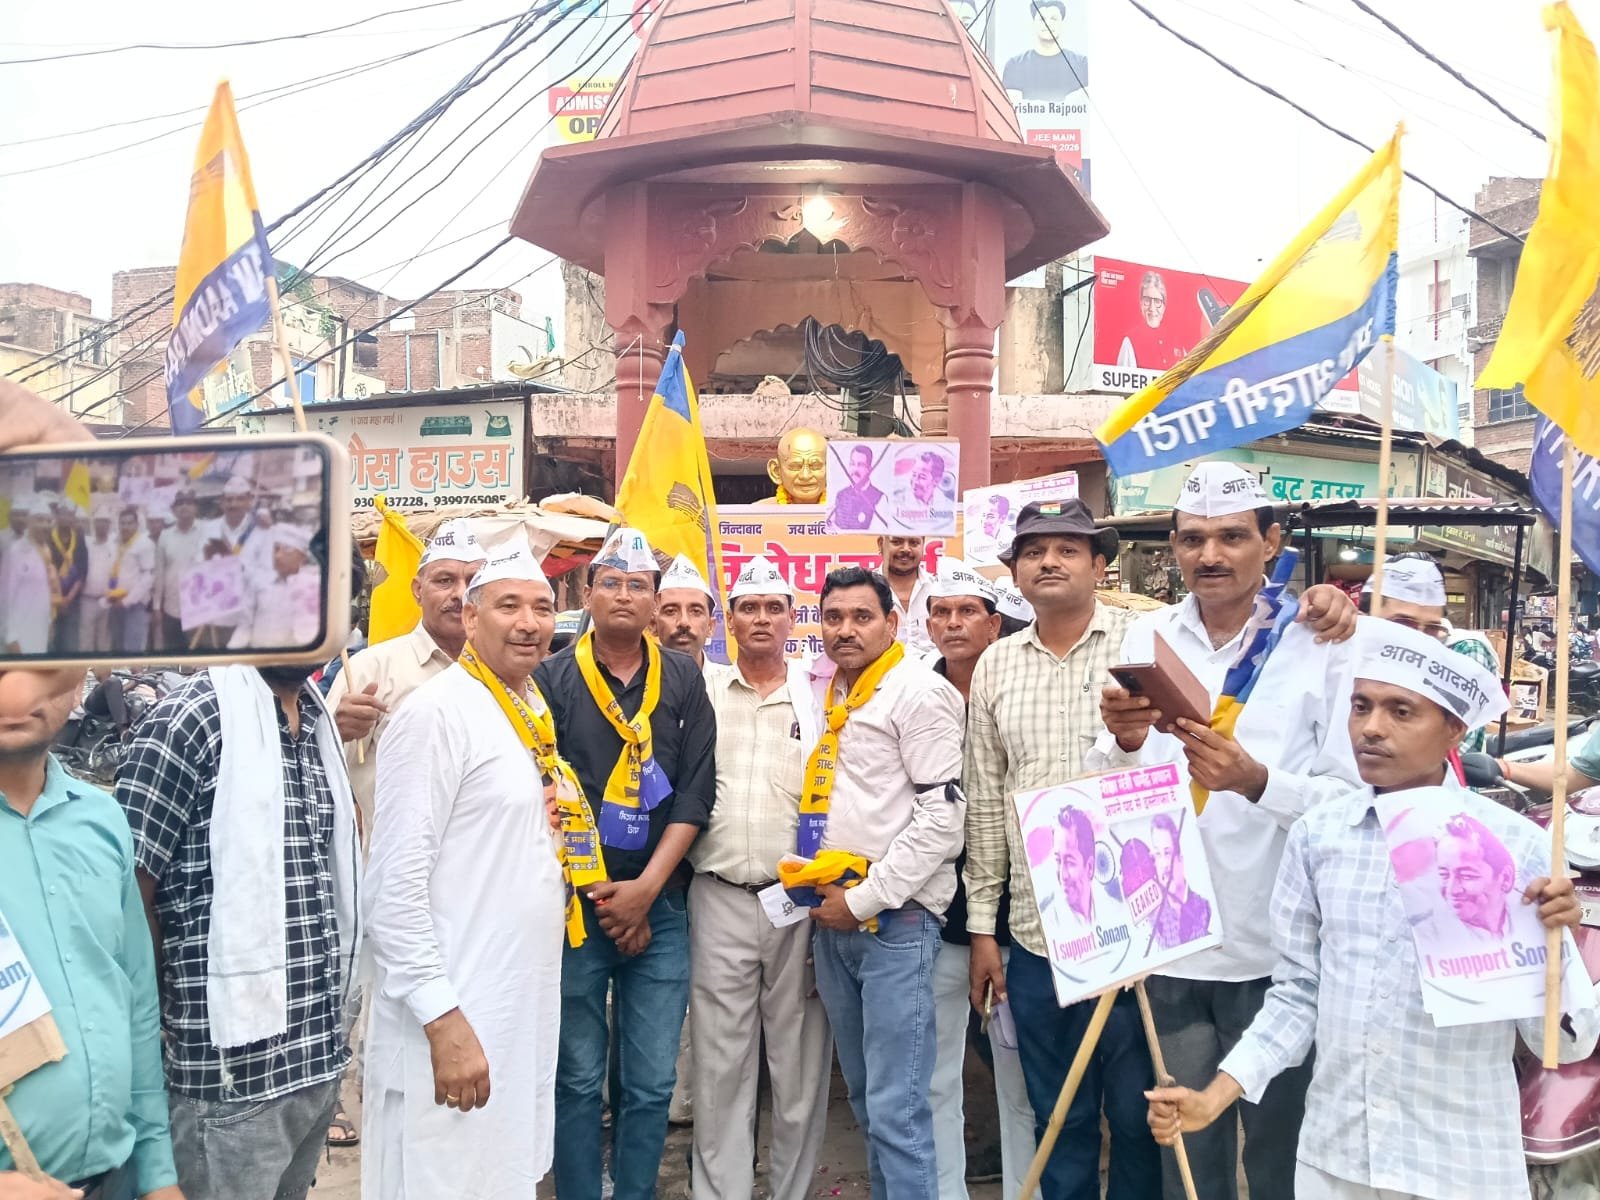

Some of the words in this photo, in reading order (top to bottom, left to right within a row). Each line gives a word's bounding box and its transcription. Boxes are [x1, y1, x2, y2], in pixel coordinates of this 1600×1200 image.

[556, 95, 610, 111] ADMISS
[1012, 103, 1046, 114] rishna
[1049, 102, 1087, 116] Rajpoot
[569, 117, 600, 134] OP
[1033, 133, 1051, 142] JEE
[1052, 132, 1076, 141] MAIN
[1060, 143, 1080, 152] 2026
[1102, 371, 1148, 389] SUPER
[408, 444, 514, 493] हाउस
[354, 497, 428, 508] 930437228,
[719, 521, 762, 535] जिन्दाबाद
[788, 524, 805, 535] जय
[1381, 645, 1427, 668] आम
[1428, 660, 1480, 701] आदमी
[1131, 884, 1160, 917] LEAKED
[1059, 930, 1097, 961] support
[1095, 924, 1130, 949] Sonam
[1438, 947, 1511, 979] support
[1511, 940, 1572, 968] Sonm
